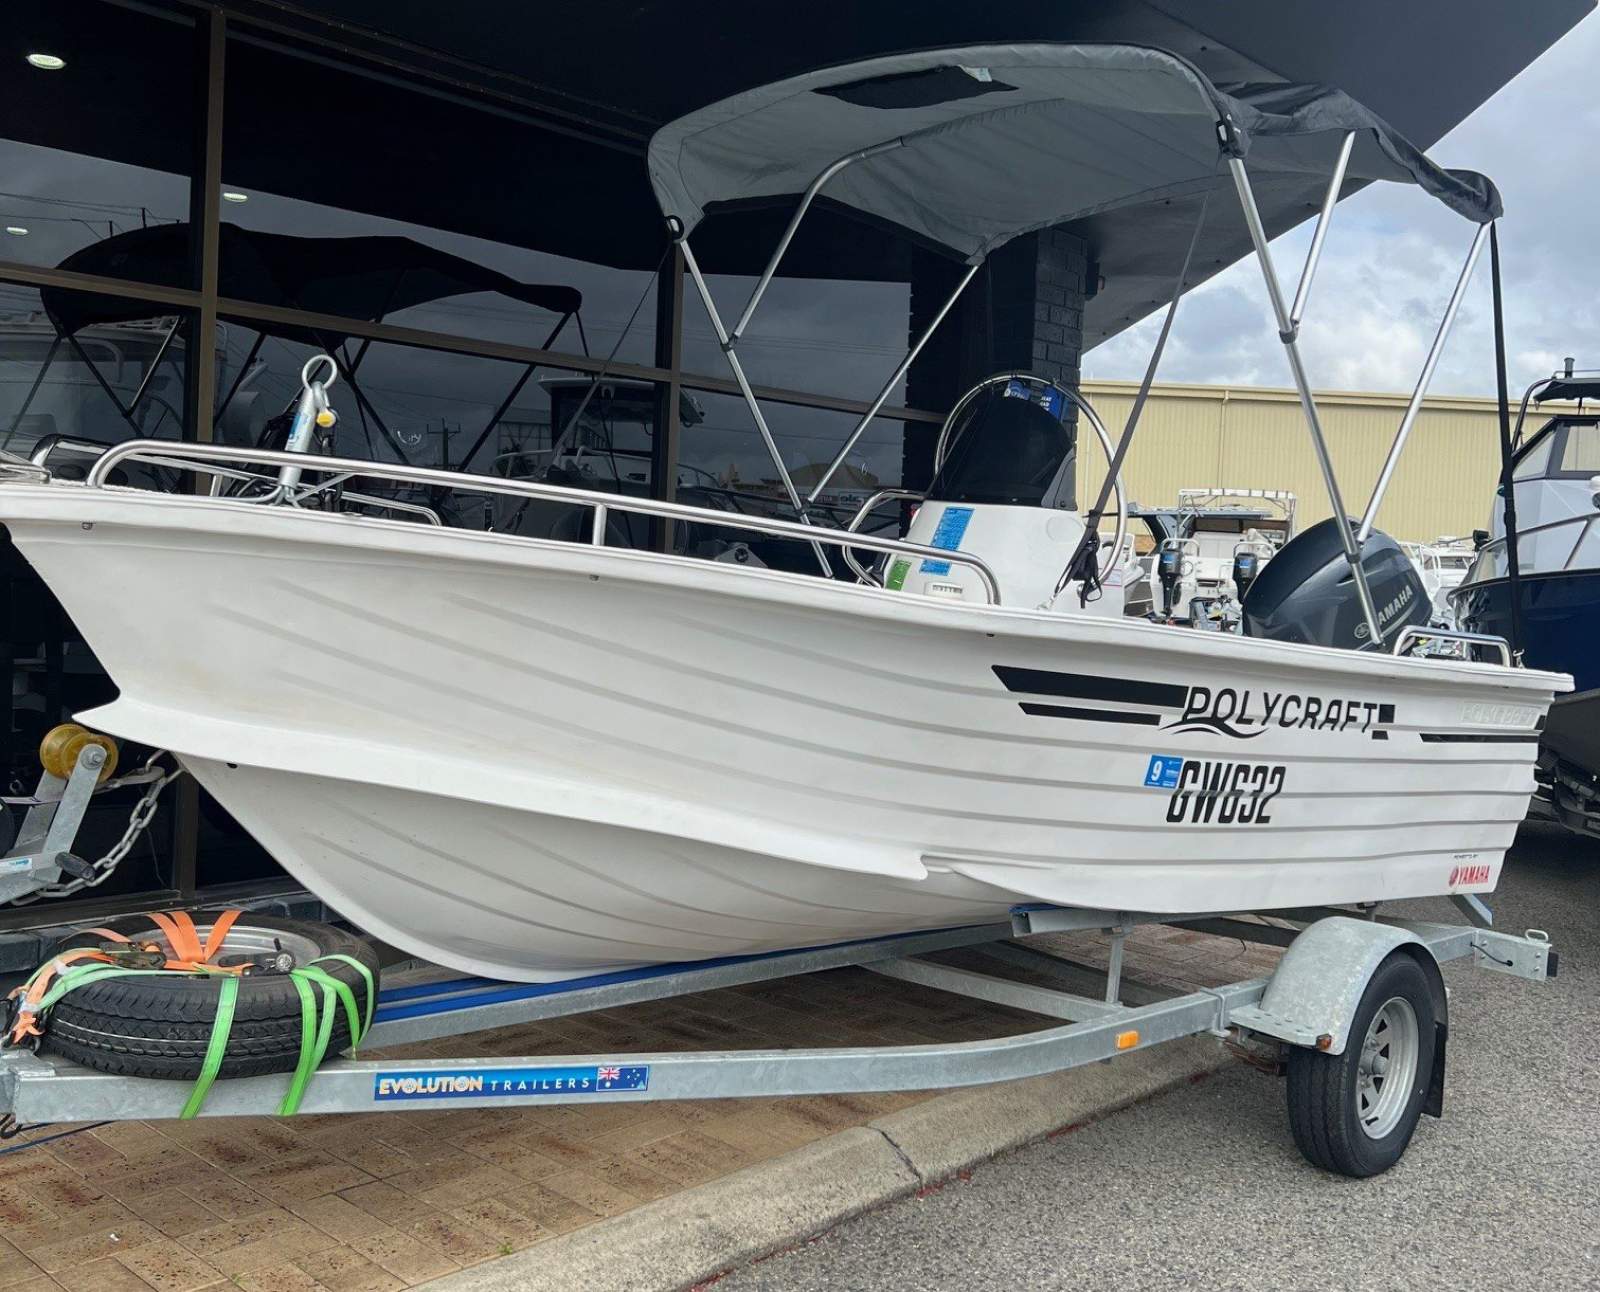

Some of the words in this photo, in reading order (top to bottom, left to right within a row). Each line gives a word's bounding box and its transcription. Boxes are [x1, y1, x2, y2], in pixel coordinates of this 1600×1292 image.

[1377, 585, 1413, 625] AMAHA
[1182, 686, 1378, 733] POLYCRAFT
[1151, 760, 1163, 781] 9
[1166, 760, 1286, 824] GW632
[1459, 865, 1490, 885] YAMAHA
[379, 1076, 483, 1094] EVOLUTION
[491, 1078, 590, 1091] TRAILERS
